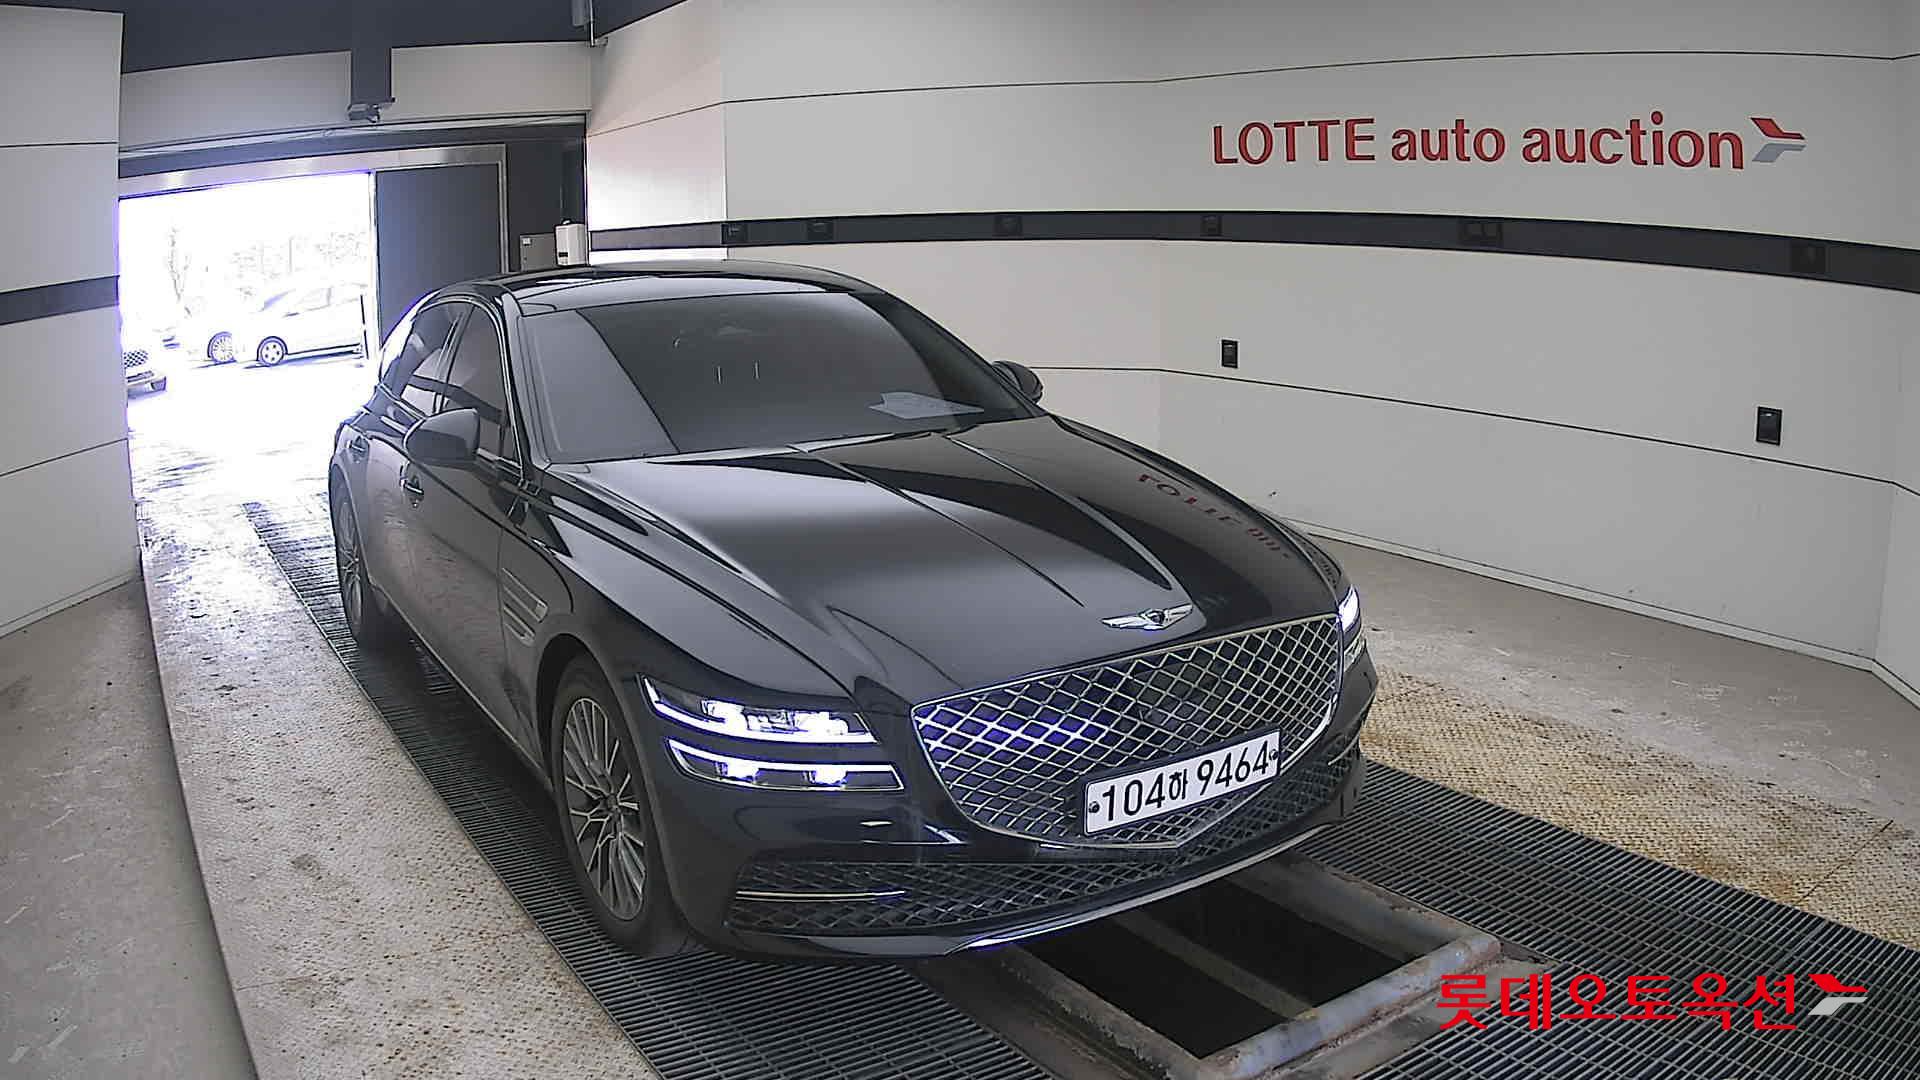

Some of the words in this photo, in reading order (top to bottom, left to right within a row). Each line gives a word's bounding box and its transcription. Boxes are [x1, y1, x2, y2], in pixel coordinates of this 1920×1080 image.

[1213, 118, 1376, 164] LOTTE
[1392, 118, 1506, 162] auto
[1522, 111, 1744, 169] auction
[1102, 768, 1188, 821] 104하
[1197, 740, 1269, 796] 9464
